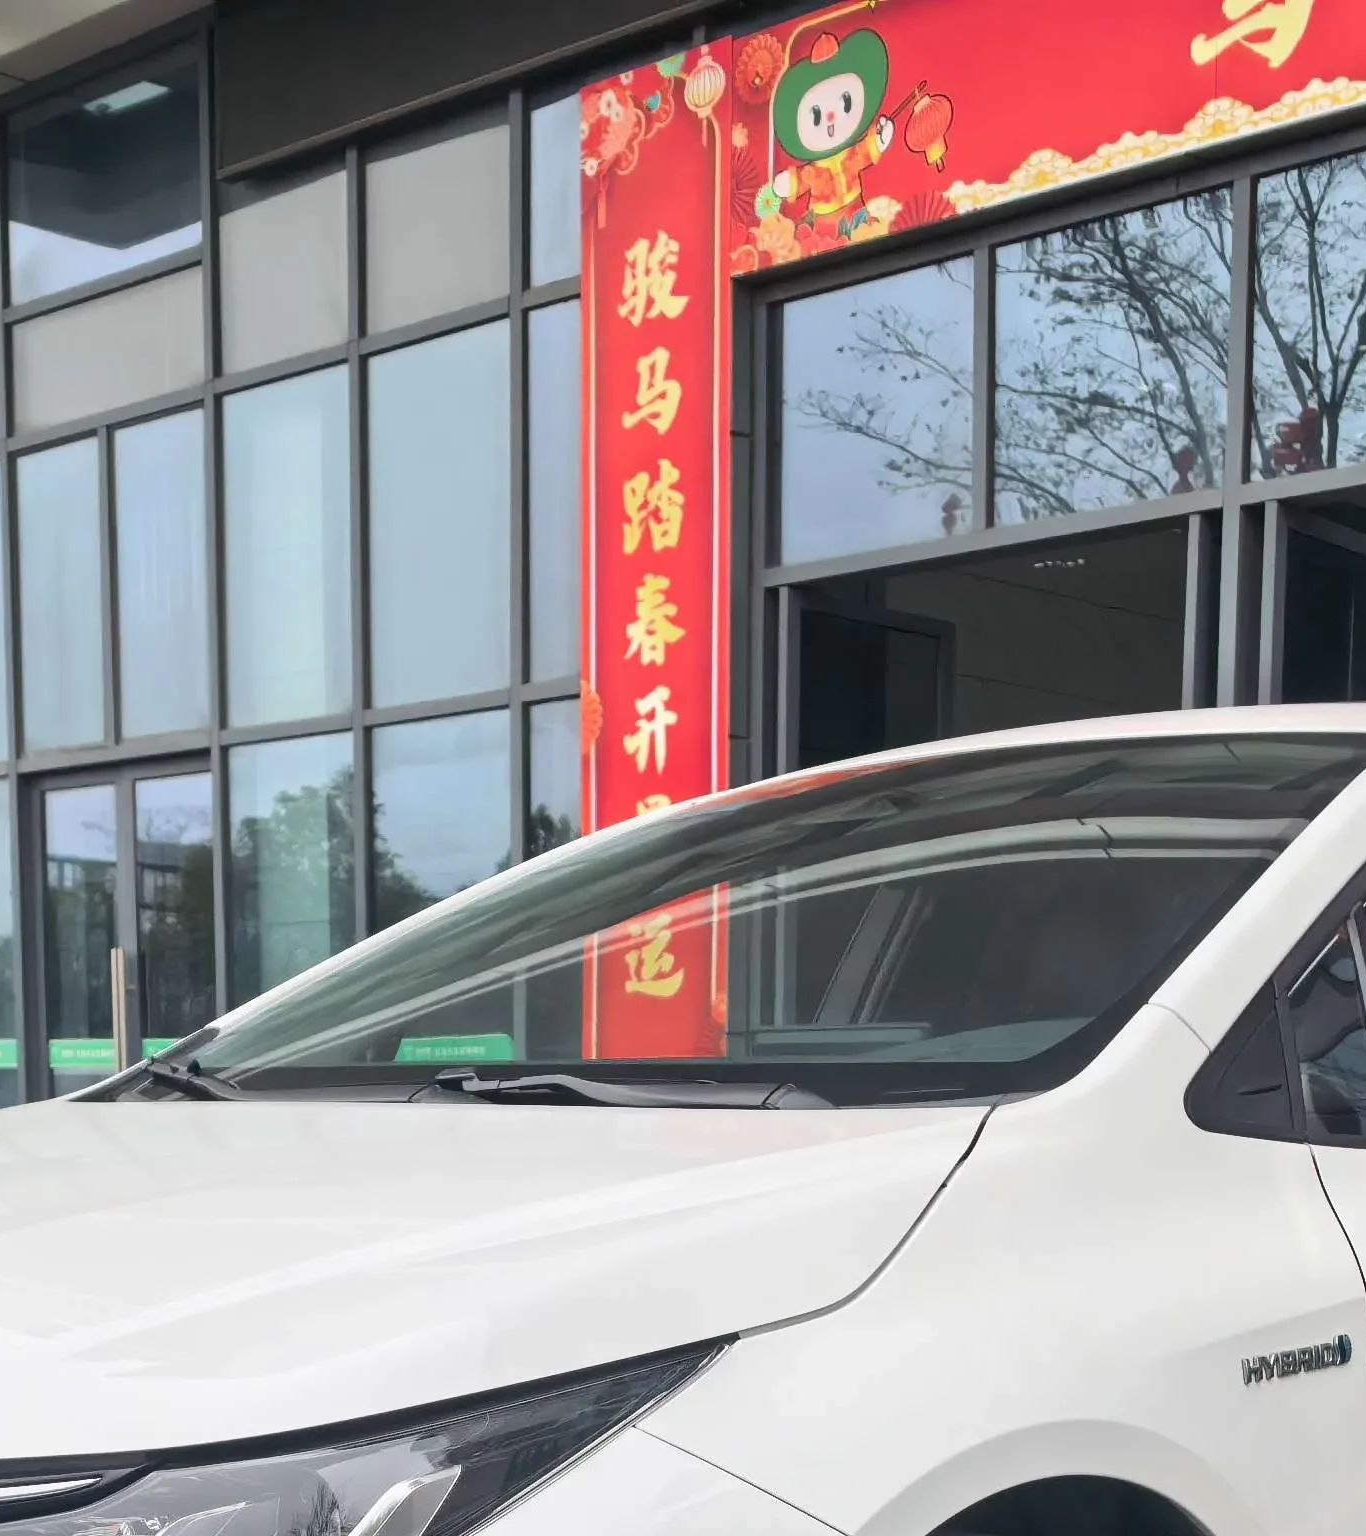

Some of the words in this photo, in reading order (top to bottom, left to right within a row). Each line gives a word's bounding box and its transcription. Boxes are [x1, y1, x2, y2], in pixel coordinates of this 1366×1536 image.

[616, 229, 692, 998] 骏马踏春开运
[1241, 1341, 1340, 1386] HYBRID
